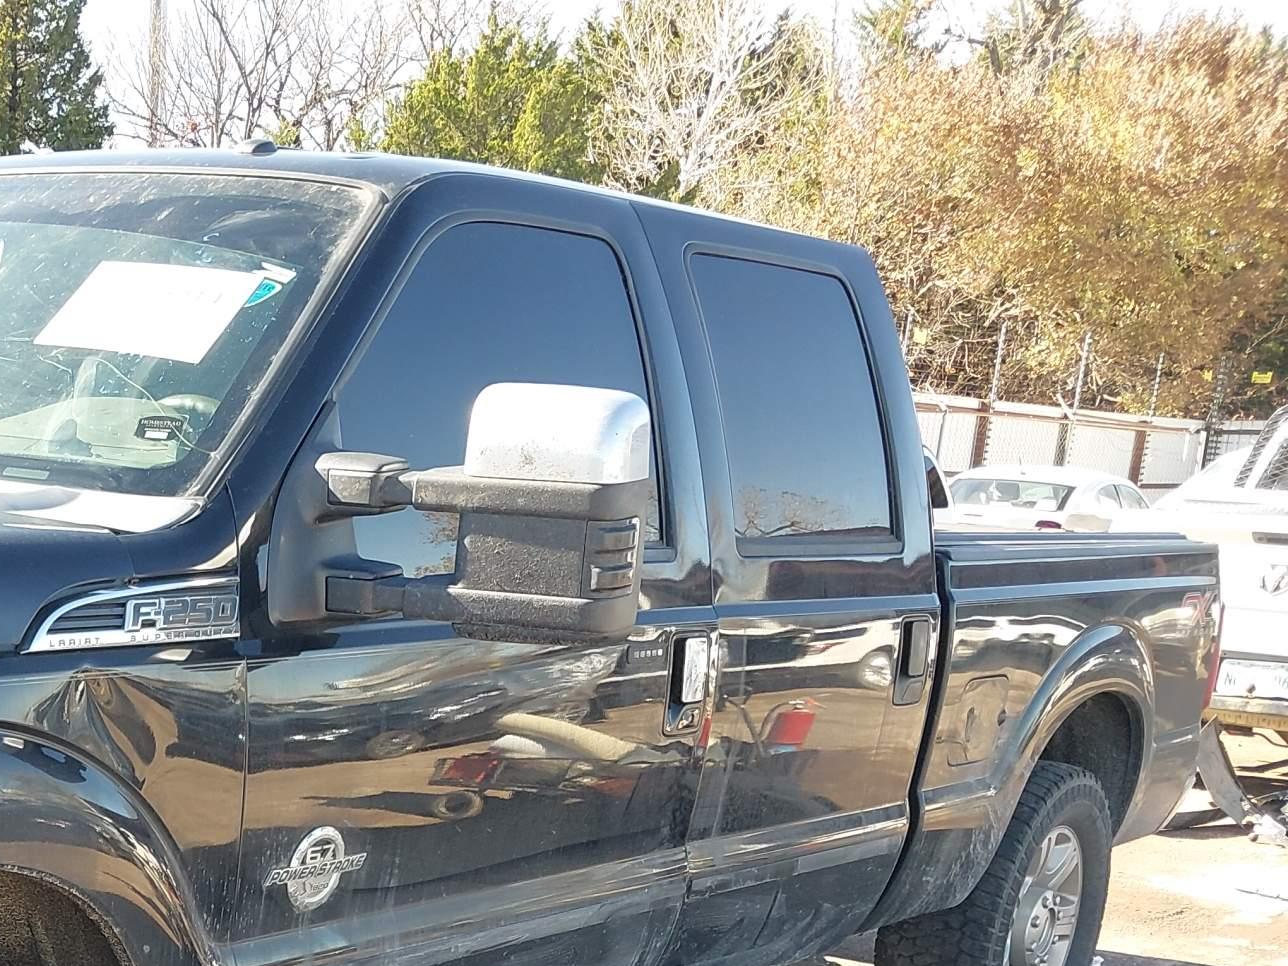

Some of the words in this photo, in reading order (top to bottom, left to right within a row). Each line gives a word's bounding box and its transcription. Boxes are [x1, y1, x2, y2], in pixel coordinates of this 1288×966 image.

[124, 597, 240, 632] F-250
[130, 629, 189, 641] SUPER
[49, 637, 100, 648] LARIAT
